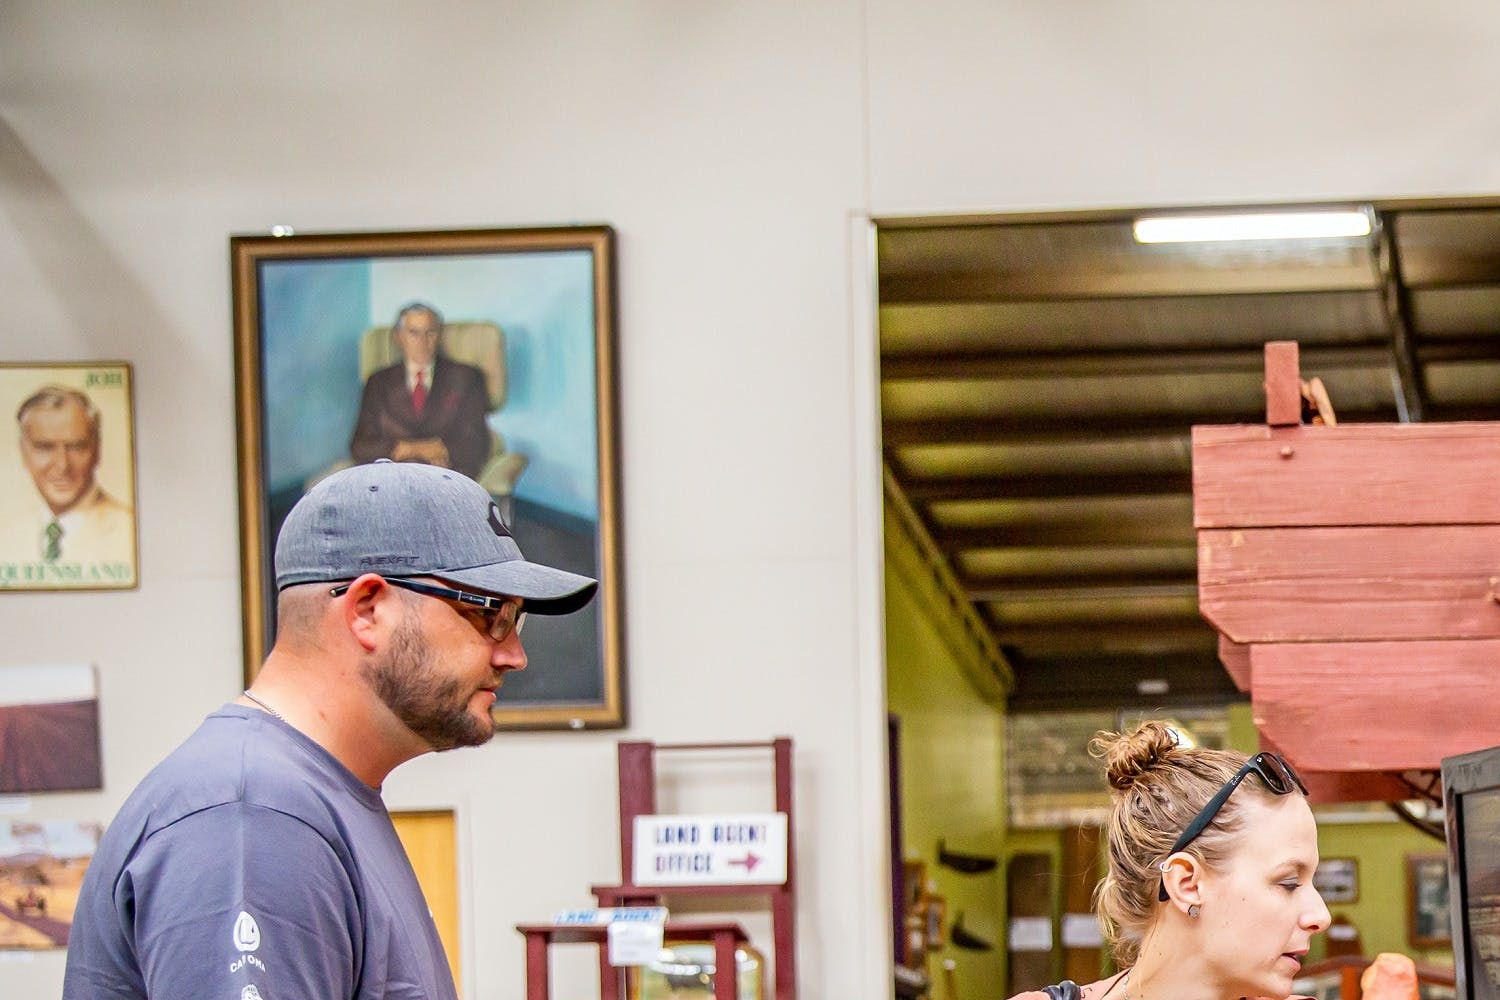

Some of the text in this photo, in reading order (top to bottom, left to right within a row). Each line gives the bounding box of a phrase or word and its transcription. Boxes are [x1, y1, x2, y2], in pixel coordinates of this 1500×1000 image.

[655, 822, 768, 845] LAND AGENT
[656, 852, 714, 874] OFFICE
